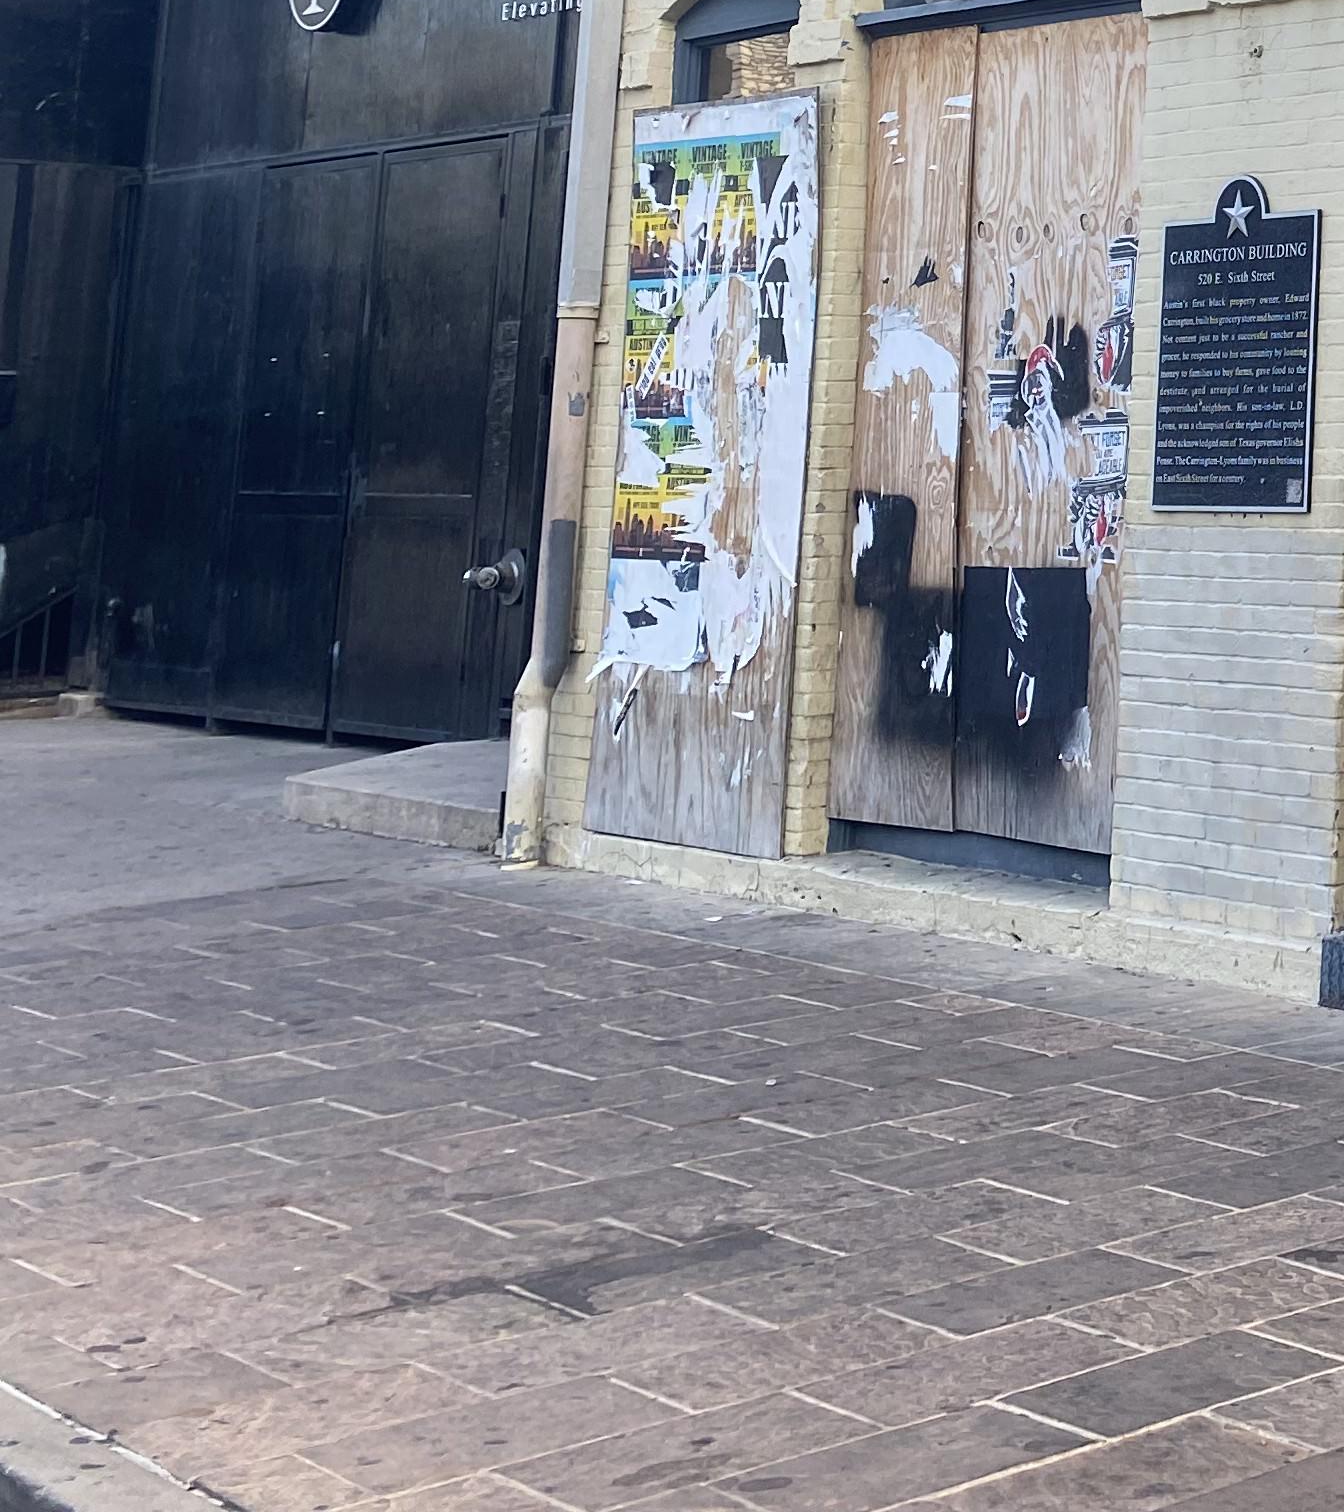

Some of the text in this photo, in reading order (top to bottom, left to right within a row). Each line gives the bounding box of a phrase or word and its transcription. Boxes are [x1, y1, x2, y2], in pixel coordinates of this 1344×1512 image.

[692, 143, 727, 162] VINTAGE
[741, 140, 774, 159] VINTAGE
[1169, 242, 1307, 265] CARRINGTON BUILDING
[1197, 273, 1212, 285] 520
[1227, 270, 1248, 283] Sixth
[1251, 269, 1275, 282] Street
